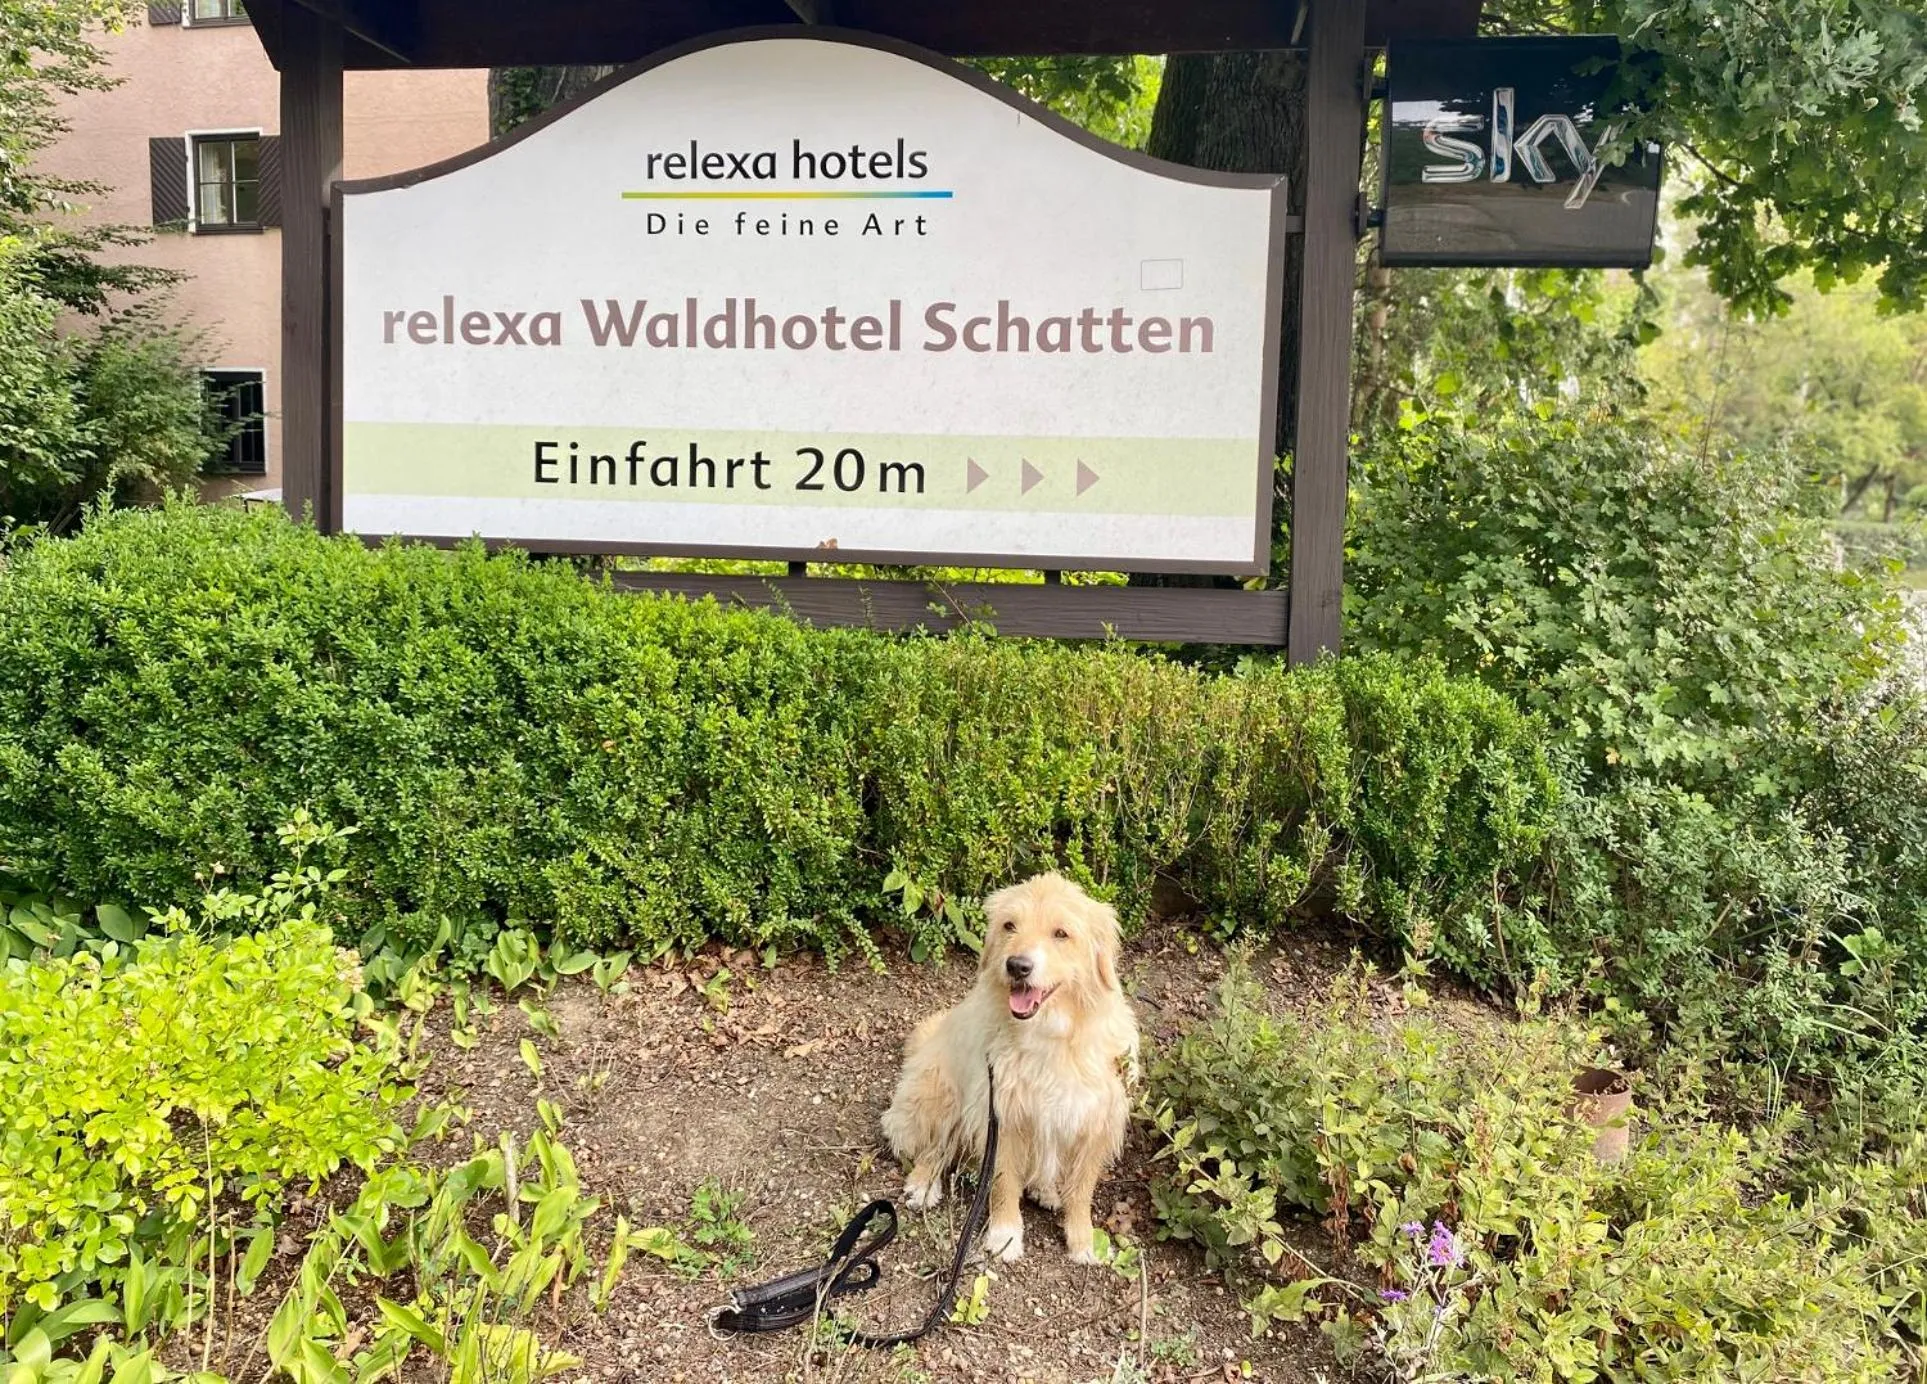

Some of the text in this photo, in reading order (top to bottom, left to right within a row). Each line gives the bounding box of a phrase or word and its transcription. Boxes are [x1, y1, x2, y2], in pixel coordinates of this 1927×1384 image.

[646, 137, 929, 180] relexa hotels
[1421, 86, 1624, 210] sky
[646, 211, 928, 236] Die feine Art
[382, 295, 1215, 354] relexa Waldhotel Schatten
[533, 440, 773, 490] Einfahrt
